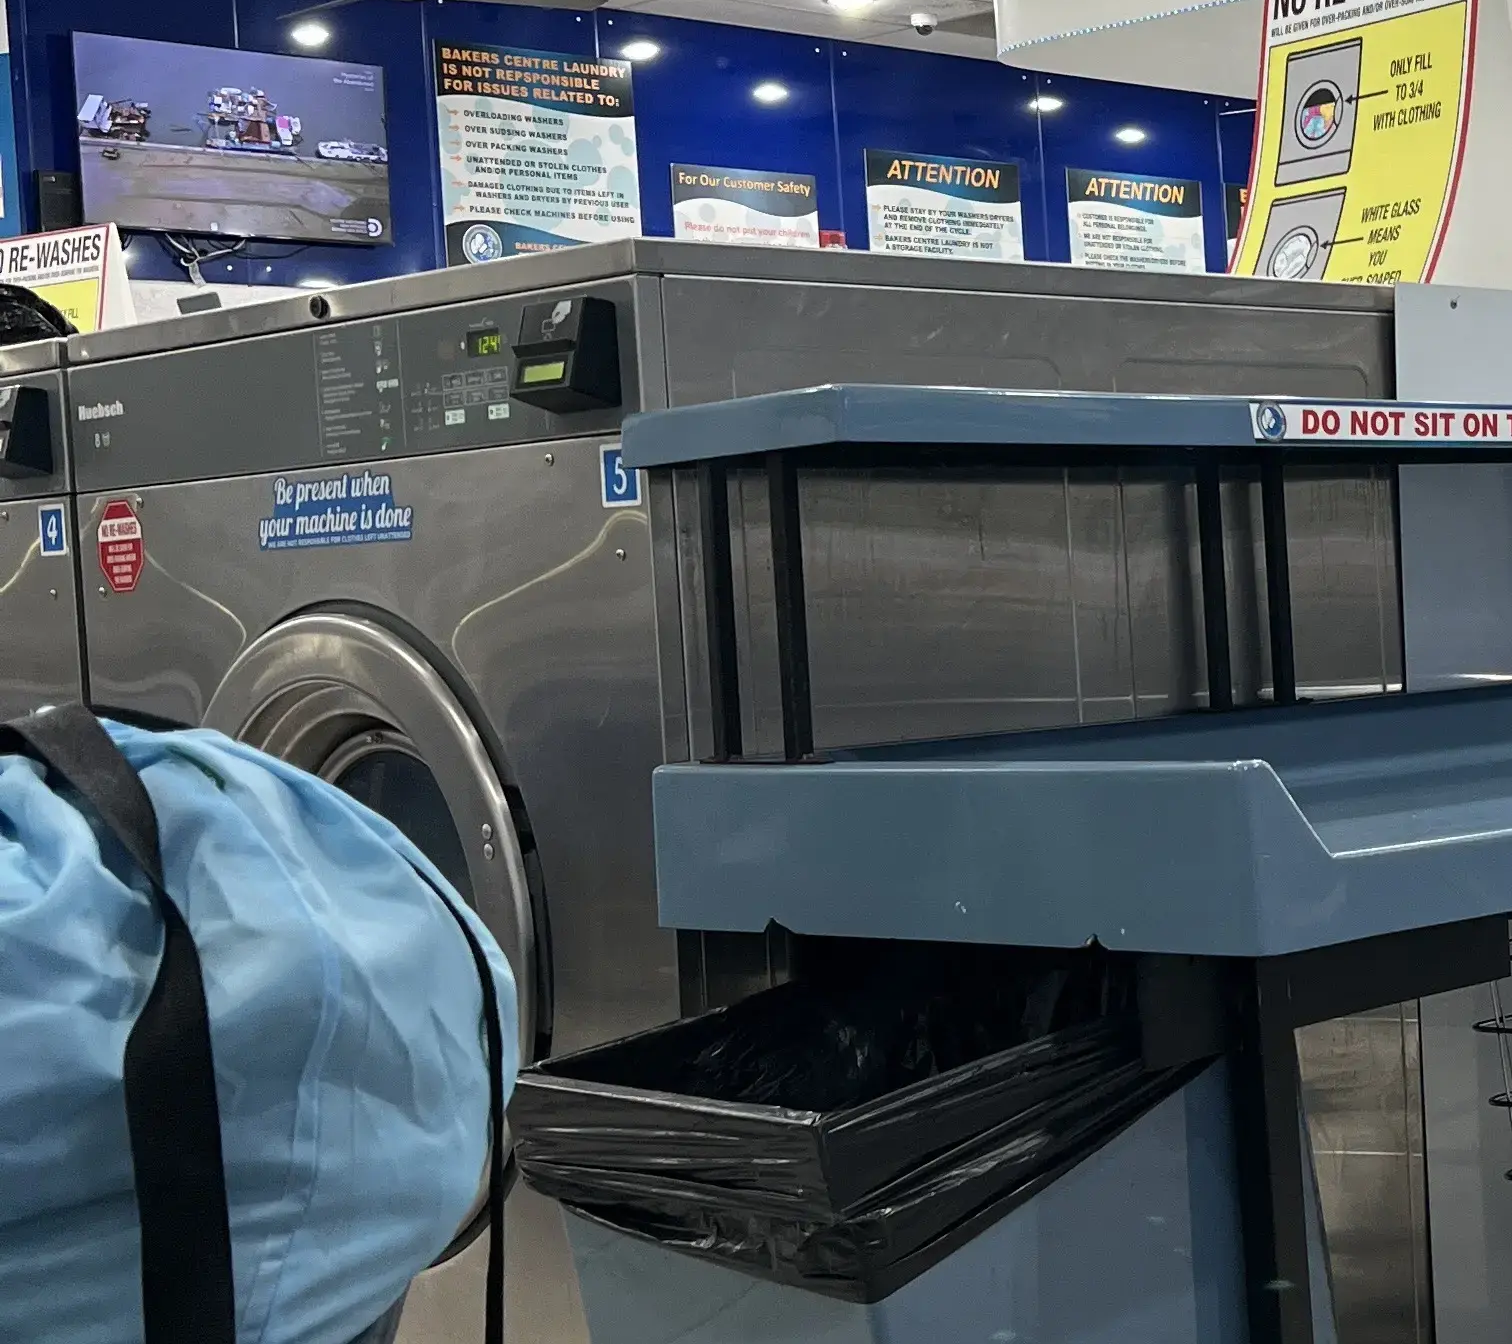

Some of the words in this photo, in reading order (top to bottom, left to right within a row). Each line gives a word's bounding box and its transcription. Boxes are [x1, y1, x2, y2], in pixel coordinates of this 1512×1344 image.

[1272, 28, 1283, 37] WILL
[1285, 25, 1292, 35] BE
[1293, 21, 1308, 32] GIVEN
[1310, 18, 1321, 28] FOR
[1322, 7, 1360, 26] OVER-PACKING
[1363, 3, 1383, 16] AND/OR
[441, 47, 499, 64] BAKERS
[504, 55, 559, 70] CENTRE
[563, 62, 626, 78] LAUNDRY
[1390, 57, 1412, 78] ONLY
[1414, 52, 1432, 72] FILL
[443, 64, 457, 75] IS
[462, 66, 492, 79] NOT
[496, 69, 600, 90] REPSPONSIBLE
[444, 79, 473, 92] FOR
[477, 82, 528, 98] ISSUES
[533, 88, 594, 104] RELATED
[598, 94, 620, 107] TO:
[1396, 83, 1406, 101] TO
[1409, 80, 1423, 99] 3/4
[464, 110, 522, 122] OVERLOADING
[525, 116, 564, 126] WASHERS
[1373, 111, 1396, 131] WITH
[1398, 102, 1441, 126] CLOTHING
[465, 125, 487, 134] OVER
[489, 127, 526, 137] SUDSING
[529, 131, 567, 141] WASHERS
[466, 141, 488, 149] OVER
[491, 144, 527, 153] PACKING
[529, 147, 568, 155] WASHERS
[467, 156, 522, 167] UNATTENDED
[538, 162, 569, 171] STOLEN
[572, 165, 607, 173] CLOTHES
[509, 169, 550, 178] PERSONAL
[887, 160, 1000, 189] ATTENTION
[468, 181, 504, 189] DAMAGED
[507, 184, 543, 193] CLOTHING
[546, 186, 560, 194] DUE
[574, 188, 596, 197] ITEMS
[598, 190, 614, 198] LEFT
[679, 173, 697, 185] For
[700, 175, 720, 186] Our
[723, 177, 775, 191] Customer
[777, 181, 810, 197] Safety
[1085, 178, 1185, 204] ATTENTION
[476, 192, 511, 200] WASHERS
[532, 195, 559, 203] DRYERS
[574, 198, 609, 207] PREVIOUS
[884, 205, 908, 213] PLEASE
[470, 206, 501, 214] PLEASE
[504, 207, 532, 216] CHECK
[535, 210, 575, 219] MACHINES
[578, 213, 608, 222] BEFORE
[611, 215, 635, 223] USING
[900, 216, 926, 224] REMOVE
[928, 218, 961, 226] CLOTHING
[1361, 204, 1390, 223] WHITE
[1391, 198, 1421, 218] GLASS
[685, 221, 711, 231] Please
[714, 224, 724, 232] do
[743, 227, 756, 235] put
[758, 229, 776, 237] your
[778, 229, 810, 238] children
[1367, 225, 1401, 244] MEANS
[892, 245, 922, 253] STORAGE
[914, 237, 939, 245] CENTRE
[941, 239, 971, 248] LAUNDRY
[9, 234, 100, 273] RE-WASHES
[1368, 250, 1388, 267] YOU
[78, 401, 124, 421] Huebsch
[1302, 410, 1340, 435] DO
[1350, 410, 1405, 436] NOT
[1414, 412, 1455, 437] SIT
[1463, 413, 1498, 437] ON
[613, 457, 627, 495] 5
[275, 478, 293, 505] Be
[295, 475, 347, 511] present
[352, 471, 389, 497] when
[47, 514, 58, 546] 4
[260, 518, 293, 546] your
[296, 506, 357, 535] machine
[360, 504, 372, 530] is
[376, 503, 411, 528] done
